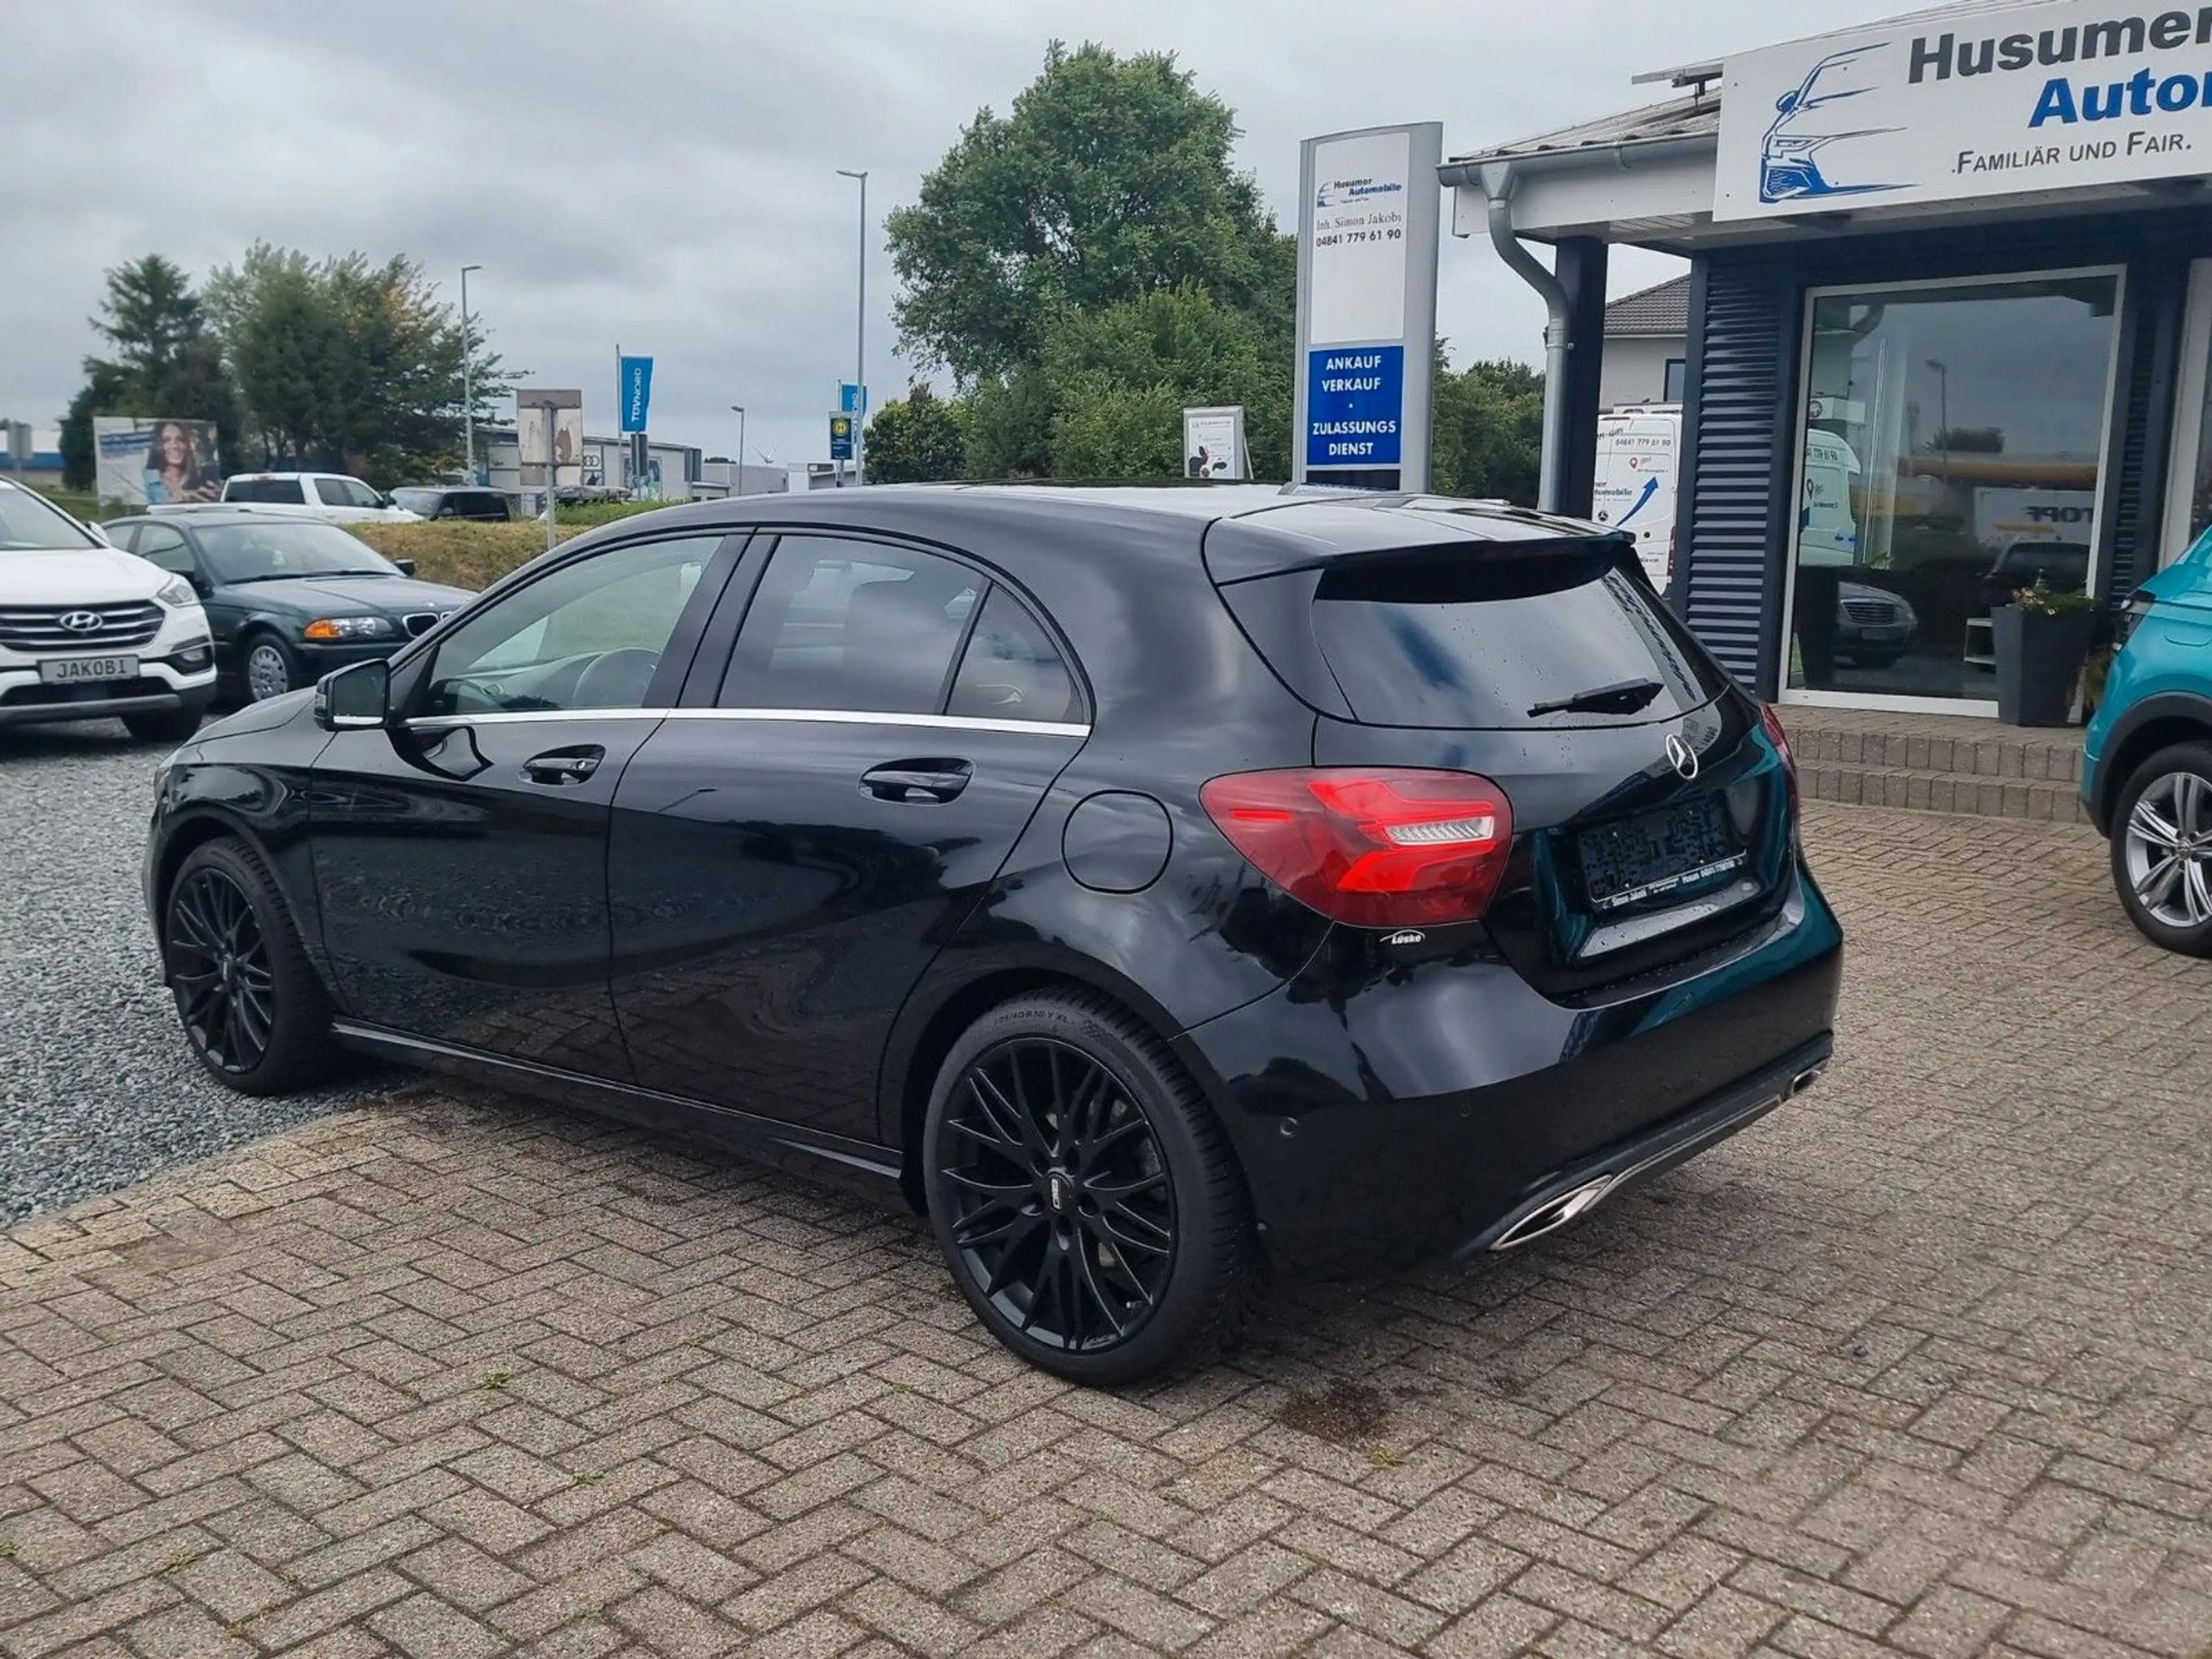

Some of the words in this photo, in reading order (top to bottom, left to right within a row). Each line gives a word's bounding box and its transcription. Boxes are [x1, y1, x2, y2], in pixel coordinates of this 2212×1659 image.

[2027, 67, 2212, 128] Auto
[1334, 178, 1373, 189] Husumer
[1348, 183, 1402, 196] Automobile
[1316, 235, 1342, 247] 04841
[1347, 232, 1366, 244] 779
[1370, 230, 1382, 241] 61
[1387, 229, 1402, 240] 90
[1326, 355, 1382, 370] ANKAUF
[1322, 377, 1382, 392] VERKAUF
[1312, 421, 1396, 435] ZULASSUNGS
[1328, 442, 1374, 456] DIENST
[56, 659, 127, 678] JAKOBI
